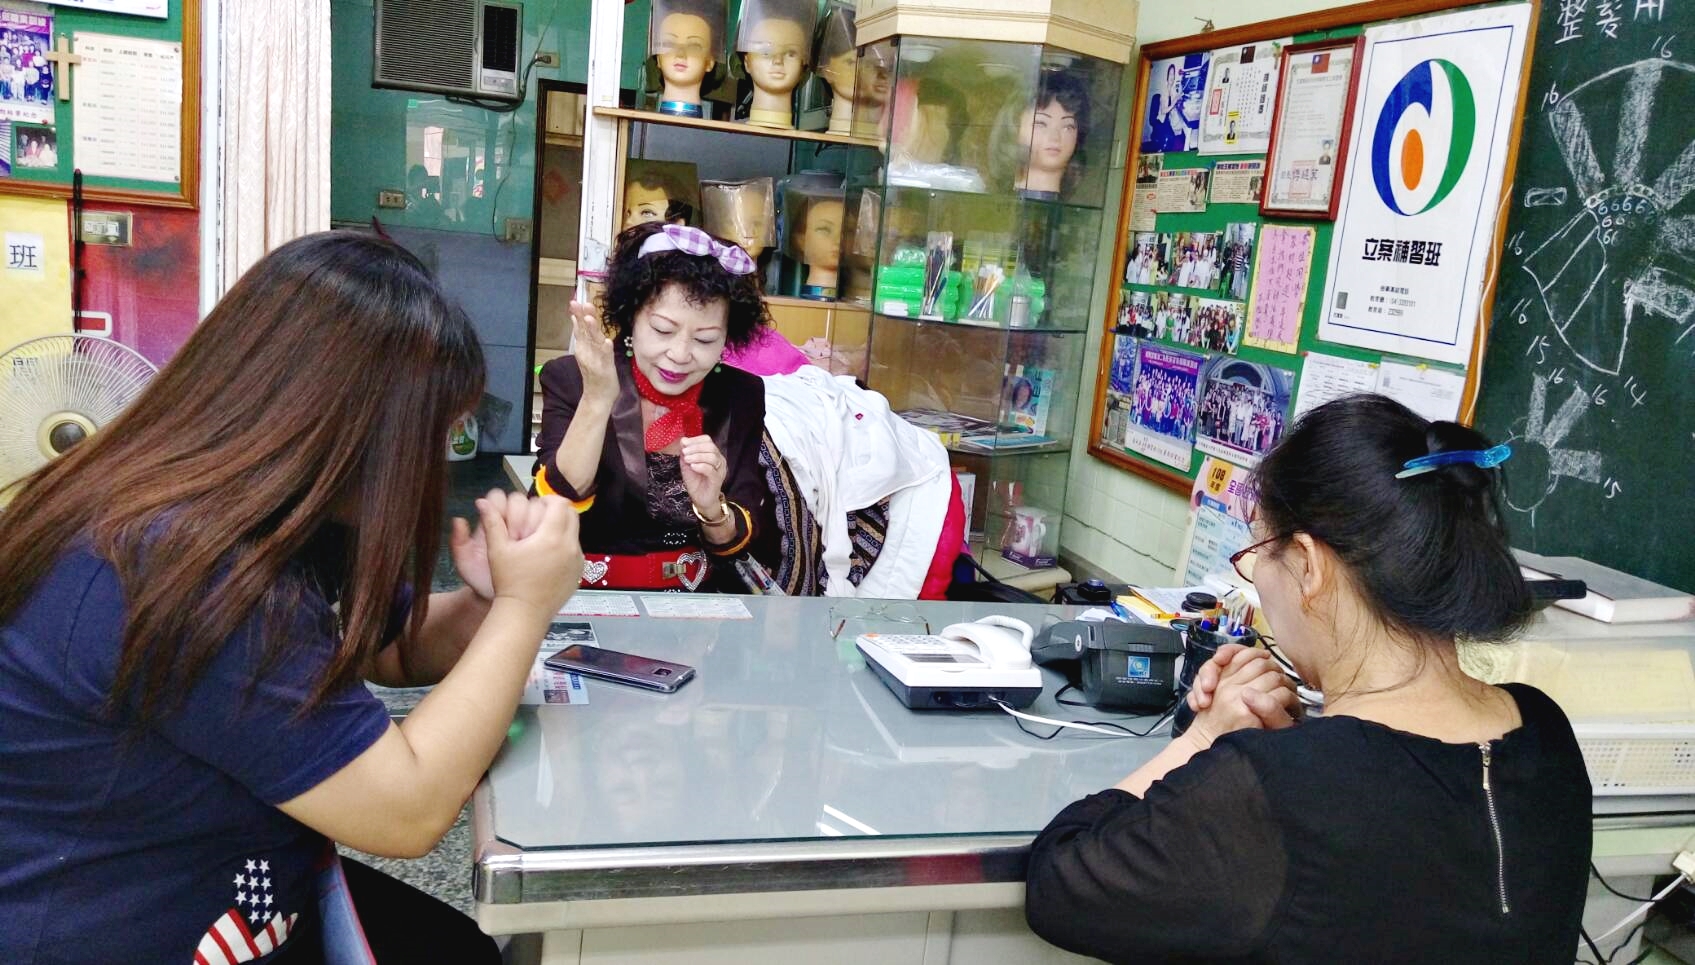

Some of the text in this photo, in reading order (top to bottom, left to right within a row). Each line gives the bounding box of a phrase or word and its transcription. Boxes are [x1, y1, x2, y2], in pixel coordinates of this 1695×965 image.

[1651, 35, 1676, 57] 16
[1541, 82, 1559, 111] 16
[1362, 238, 1443, 267] 立案補習班
[1508, 231, 1525, 255] 16
[9, 244, 38, 268] 班
[1526, 335, 1551, 364] 15
[1547, 367, 1565, 384] 16
[1592, 384, 1608, 405] 16
